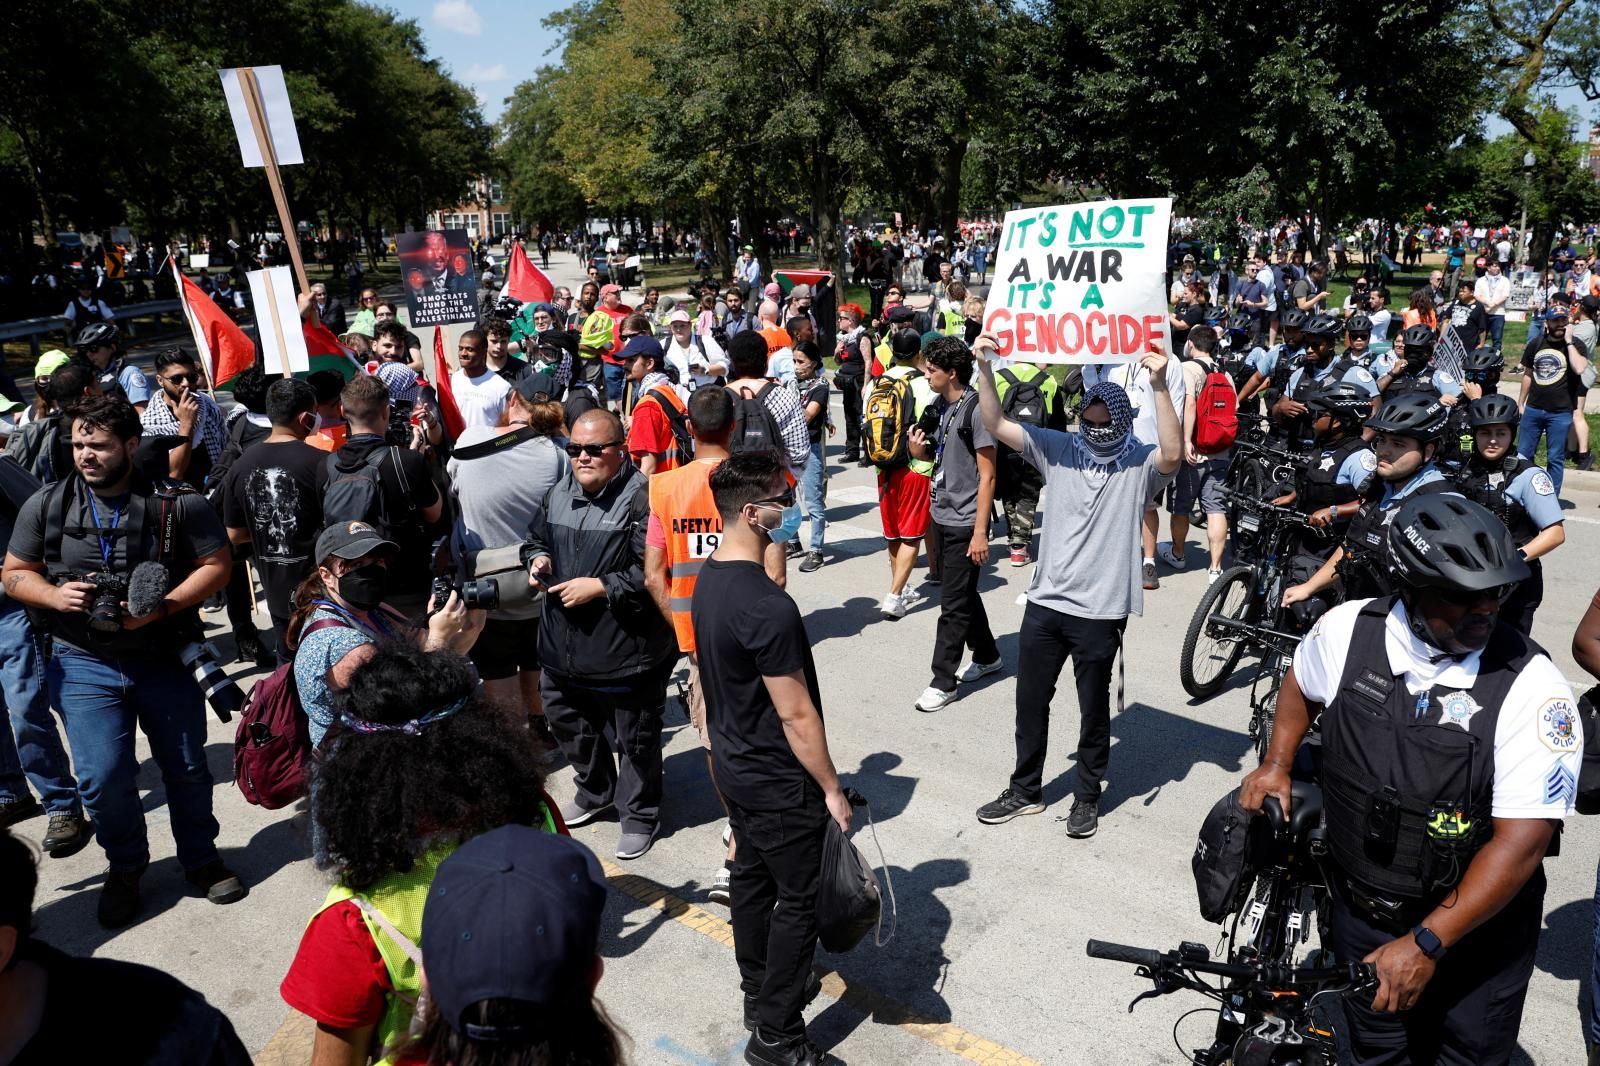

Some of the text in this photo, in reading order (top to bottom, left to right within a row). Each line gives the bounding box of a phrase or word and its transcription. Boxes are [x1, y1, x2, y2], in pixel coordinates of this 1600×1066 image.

[1005, 205, 1155, 251] IT'S NOT
[1008, 249, 1123, 284] A WAR
[417, 292, 468, 303] DEMOCRATS
[1007, 278, 1104, 310] IT'S A
[416, 307, 459, 317] GENOCIDE
[423, 301, 446, 309] FUND
[415, 311, 476, 324] PALESTINIANS
[985, 308, 1165, 357] GENOCIDE
[1403, 525, 1430, 555] POLICE
[1544, 702, 1576, 722] CHICAGO
[1546, 731, 1577, 747] POLICE
